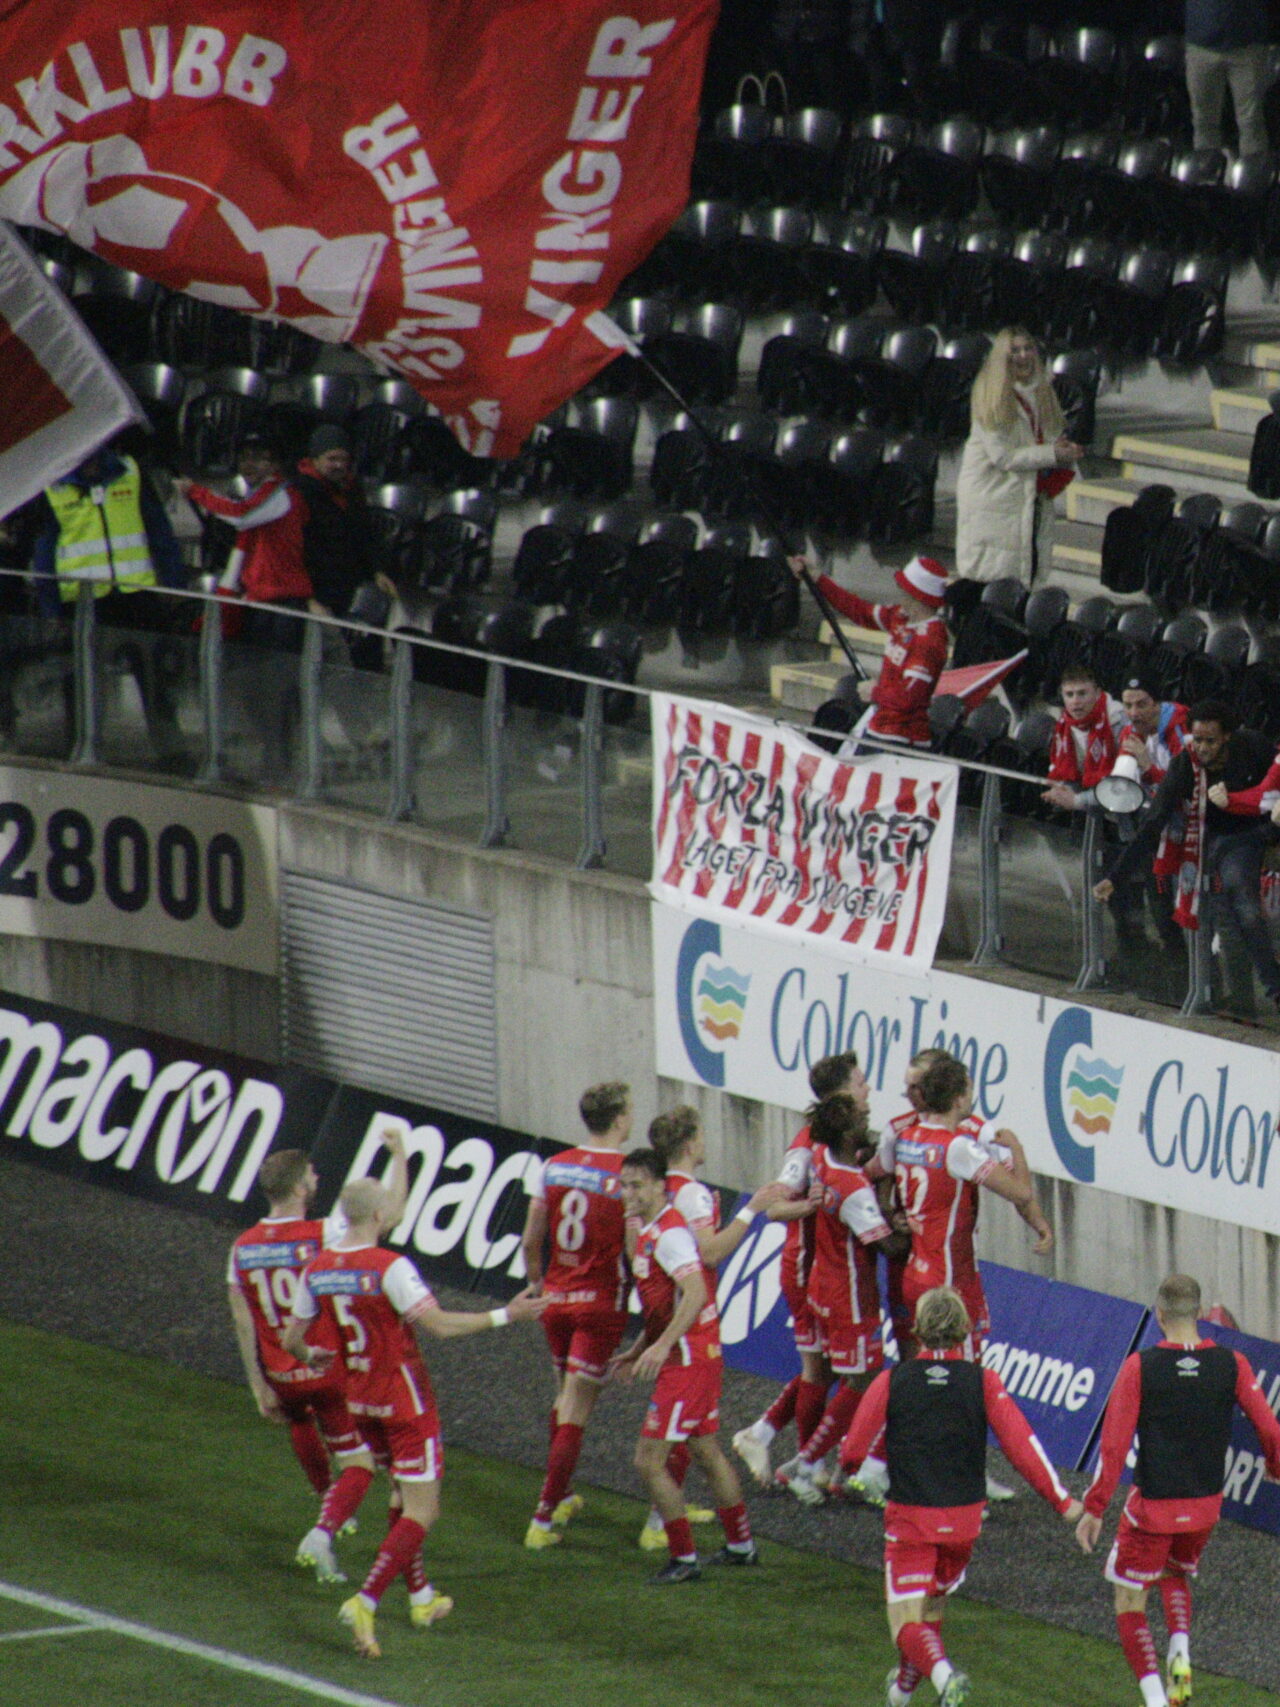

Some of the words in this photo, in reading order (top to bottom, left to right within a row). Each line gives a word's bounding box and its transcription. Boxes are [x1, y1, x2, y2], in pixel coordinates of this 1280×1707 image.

[0, 802, 245, 930] 28000
[668, 745, 786, 836] FORZA
[800, 790, 940, 872] VINGER
[683, 831, 764, 888] LAGET
[754, 857, 801, 896] FRA
[770, 967, 901, 1092] Color
[0, 1008, 284, 1202] macron
[1145, 1060, 1280, 1189] Color
[329, 1110, 548, 1278] mac
[556, 1189, 589, 1251] 8
[332, 1294, 367, 1353] 5
